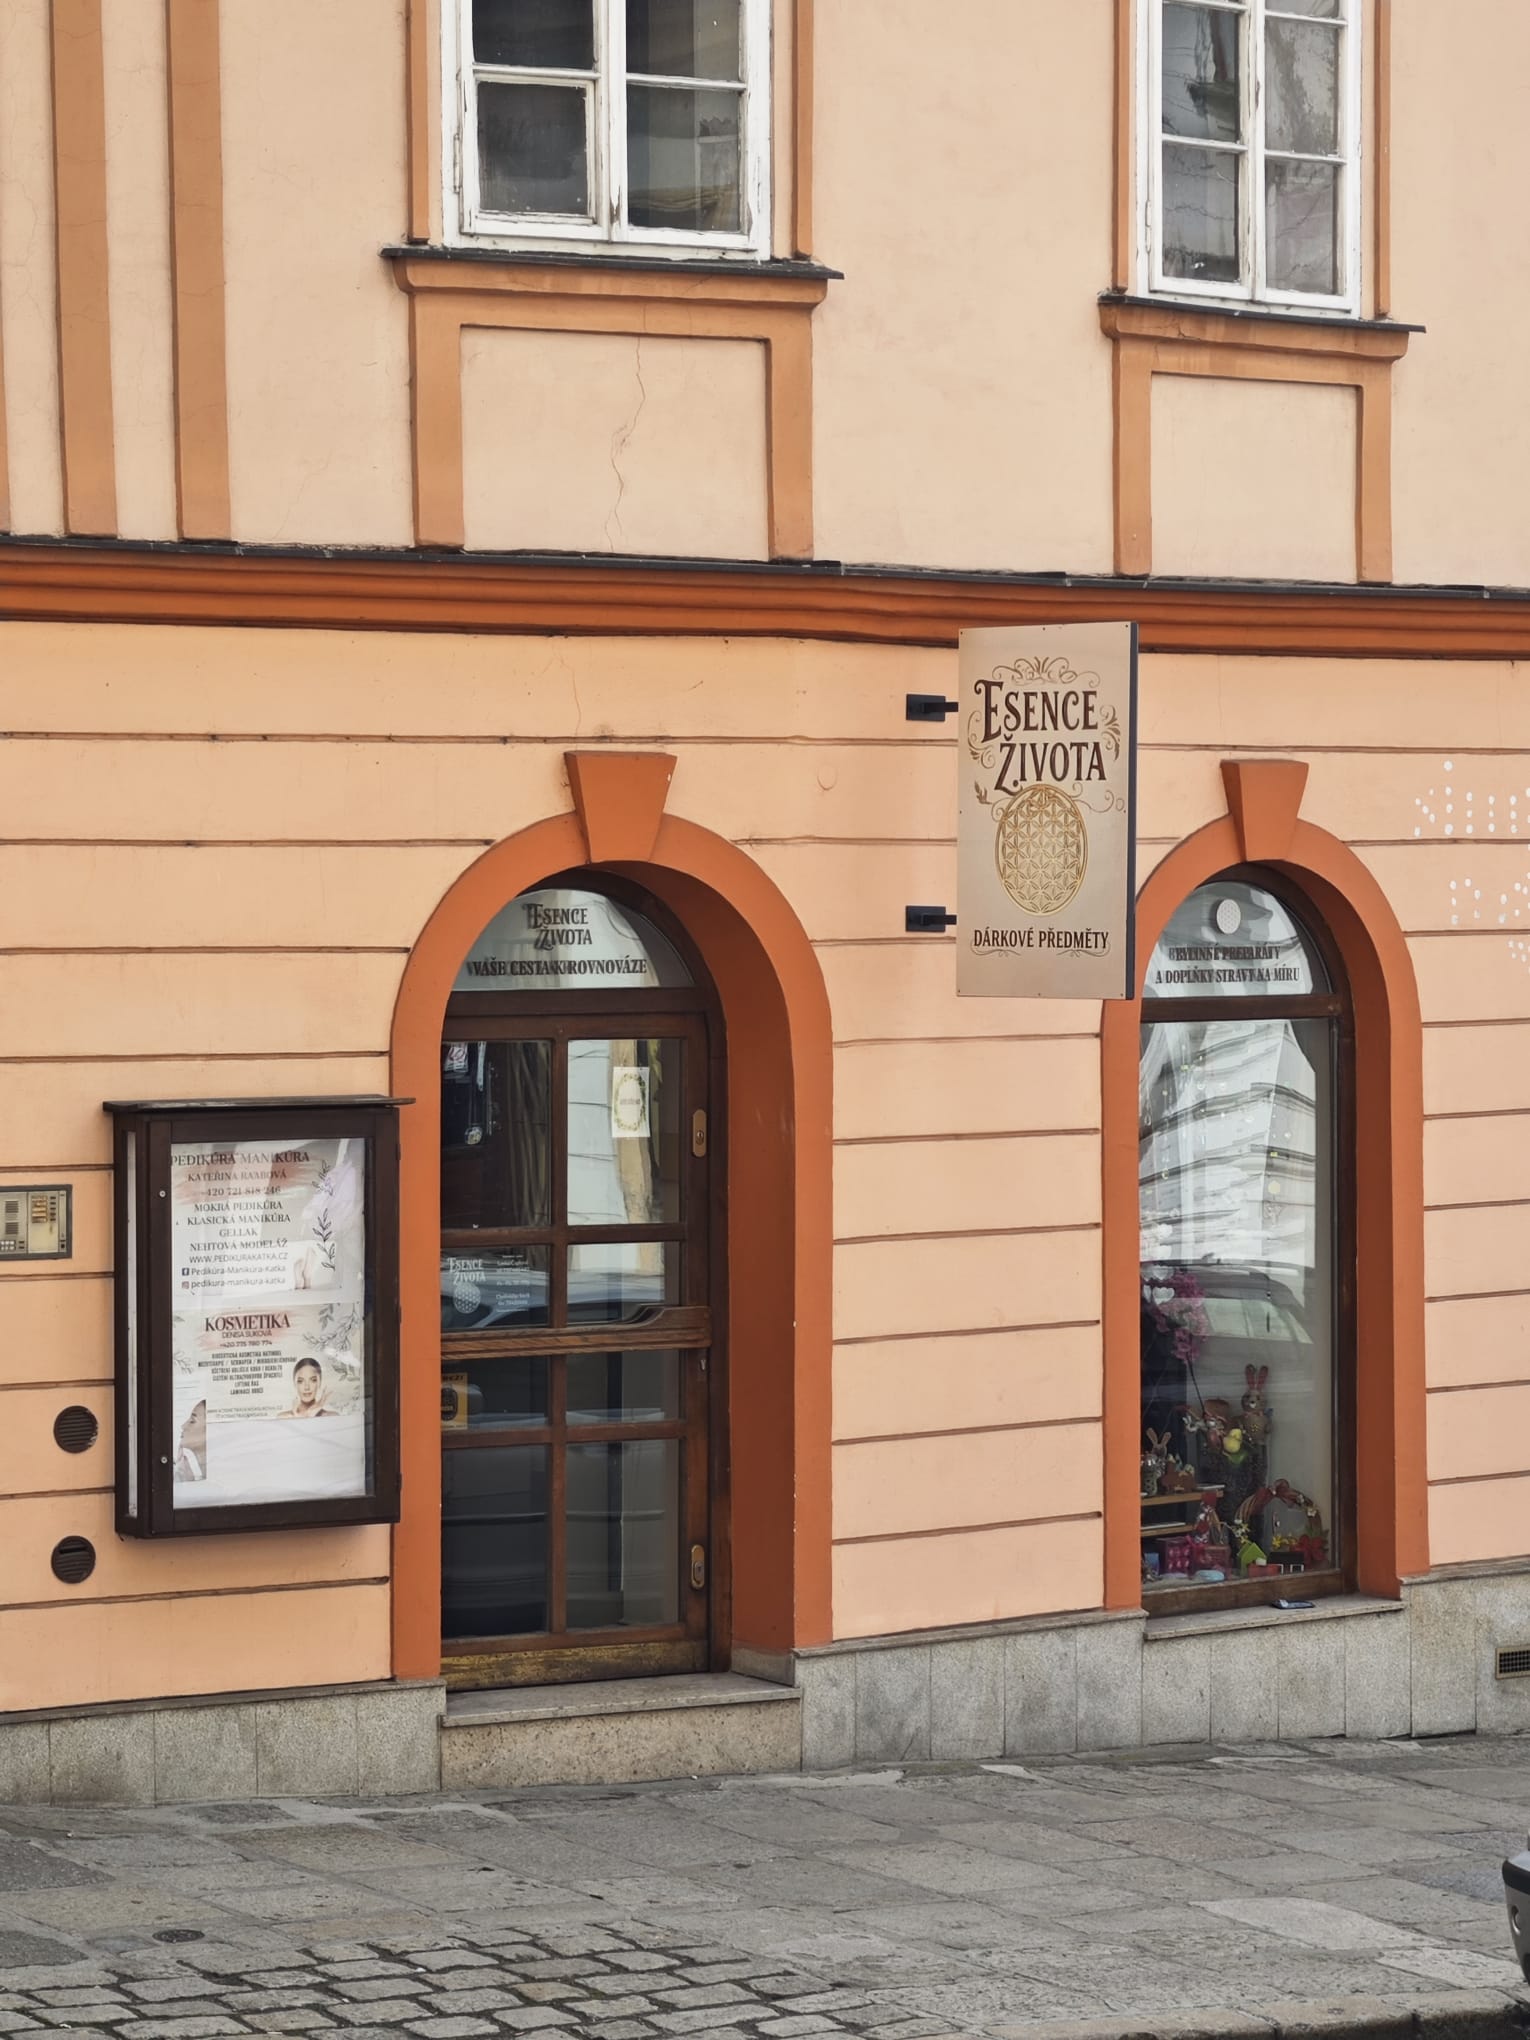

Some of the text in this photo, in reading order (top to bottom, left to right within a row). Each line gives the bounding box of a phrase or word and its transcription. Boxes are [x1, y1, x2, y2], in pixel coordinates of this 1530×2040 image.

[974, 680, 1099, 743] ESENCE
[994, 733, 1106, 796] ŽIVOTA
[522, 903, 589, 930] ESENCE
[534, 926, 593, 951] ŽIVOTA
[974, 927, 1110, 949] DÁRKOVÉ PŘEDMĚTY
[471, 956, 507, 977] VAŠE
[509, 960, 552, 976] CESTA
[567, 955, 648, 975] ROVNOVÁZE
[1155, 970, 1163, 984] A
[1165, 965, 1214, 984] DOPLŇKY
[1215, 968, 1255, 983] STRAVY
[1273, 963, 1300, 981] MÍRU
[171, 1150, 310, 1167] PEDIKÚRA MANIKÚRA
[193, 1202, 231, 1213] MOKRÁ
[187, 1215, 236, 1226] KLASICKÁ
[205, 1313, 291, 1332] KOSMETIKA
